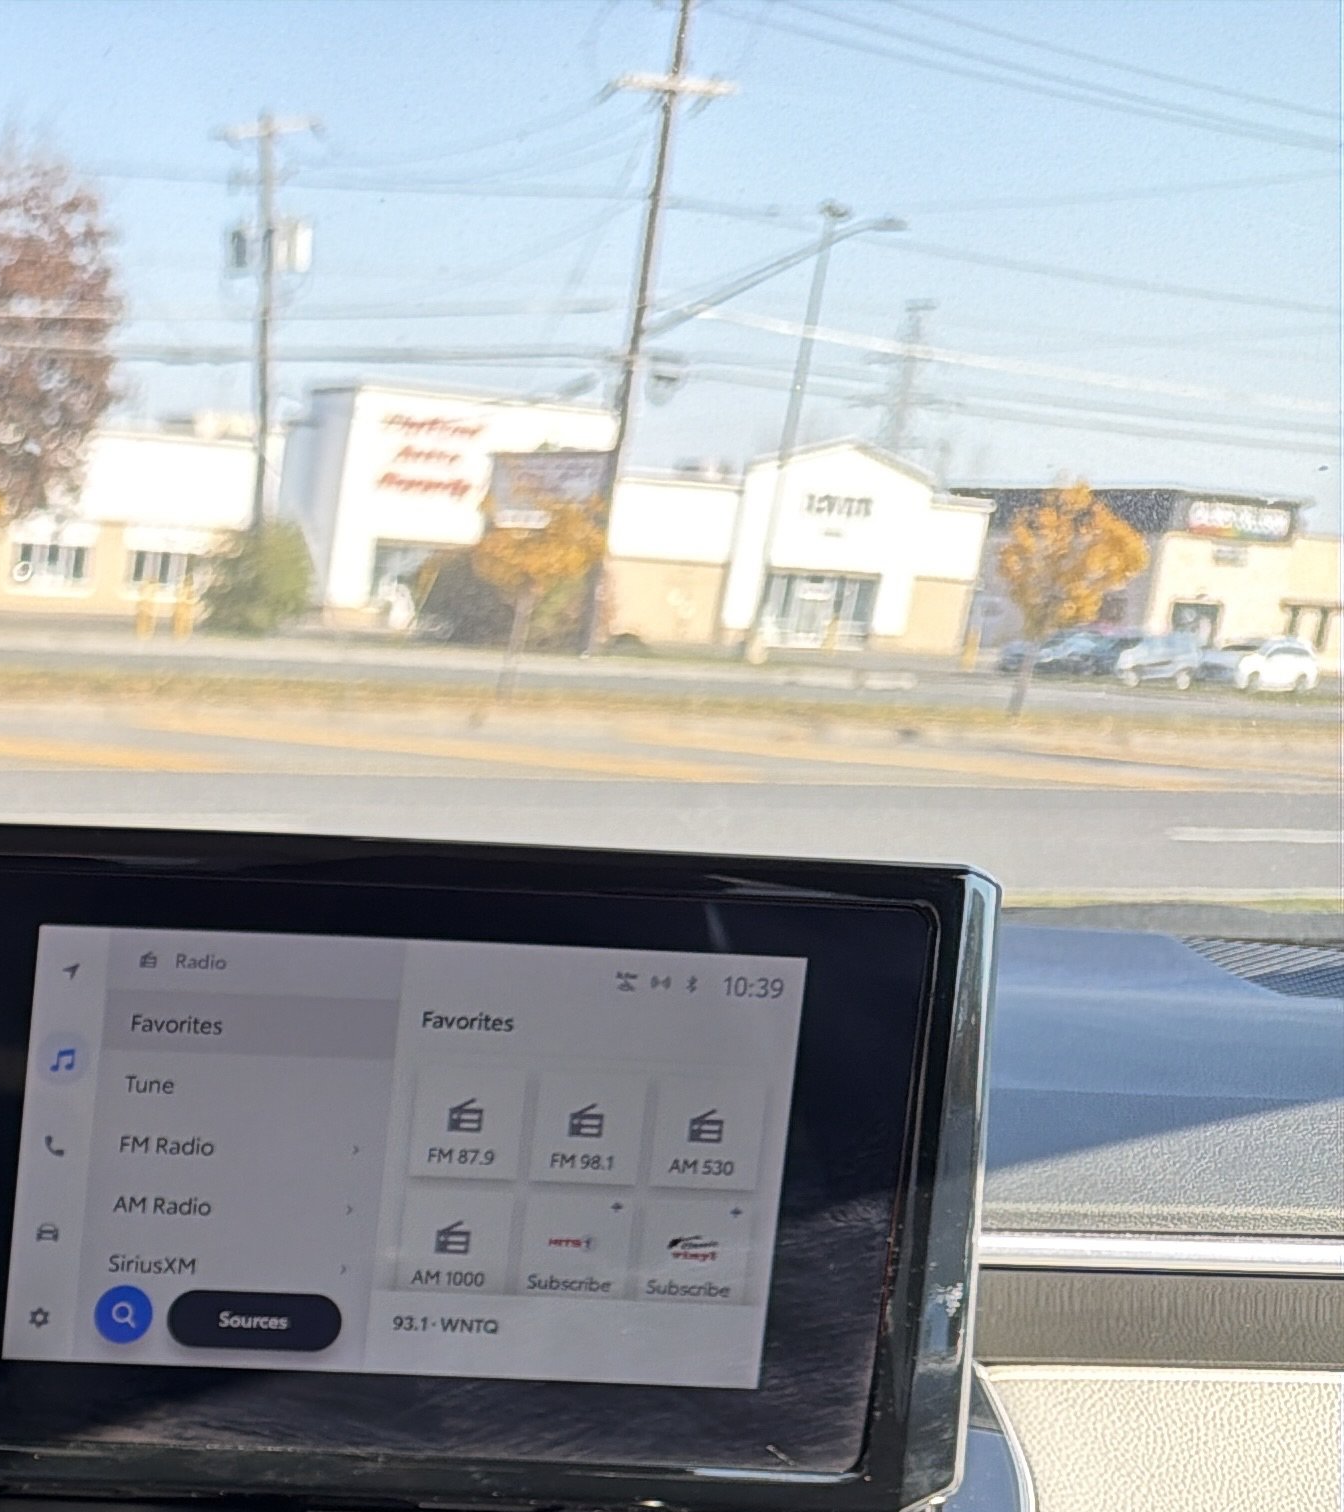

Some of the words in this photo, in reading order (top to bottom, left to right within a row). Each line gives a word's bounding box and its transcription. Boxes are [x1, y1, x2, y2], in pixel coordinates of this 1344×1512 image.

[176, 953, 227, 970] Radio
[723, 975, 785, 999] 10:39
[130, 1013, 223, 1036] Favorites
[421, 1010, 515, 1032] Favorites
[124, 1074, 175, 1094] Tune
[119, 1135, 149, 1154] FM
[155, 1136, 215, 1157] Radio
[427, 1146, 454, 1164] FM
[458, 1148, 495, 1167] 87.9
[549, 1152, 576, 1170] FM
[578, 1154, 615, 1171] 98.1
[668, 1158, 698, 1176] AM
[702, 1159, 735, 1177] 530
[112, 1195, 147, 1214] AM
[152, 1197, 212, 1217] Radio
[108, 1254, 197, 1276] SiriusXM
[410, 1270, 440, 1287] AM
[445, 1271, 485, 1288] 1000
[527, 1273, 612, 1294] Subscribe
[646, 1279, 732, 1299] Subscribe
[218, 1310, 289, 1330] Sources
[391, 1316, 429, 1332] 93.1
[440, 1317, 500, 1335] WNTQ
